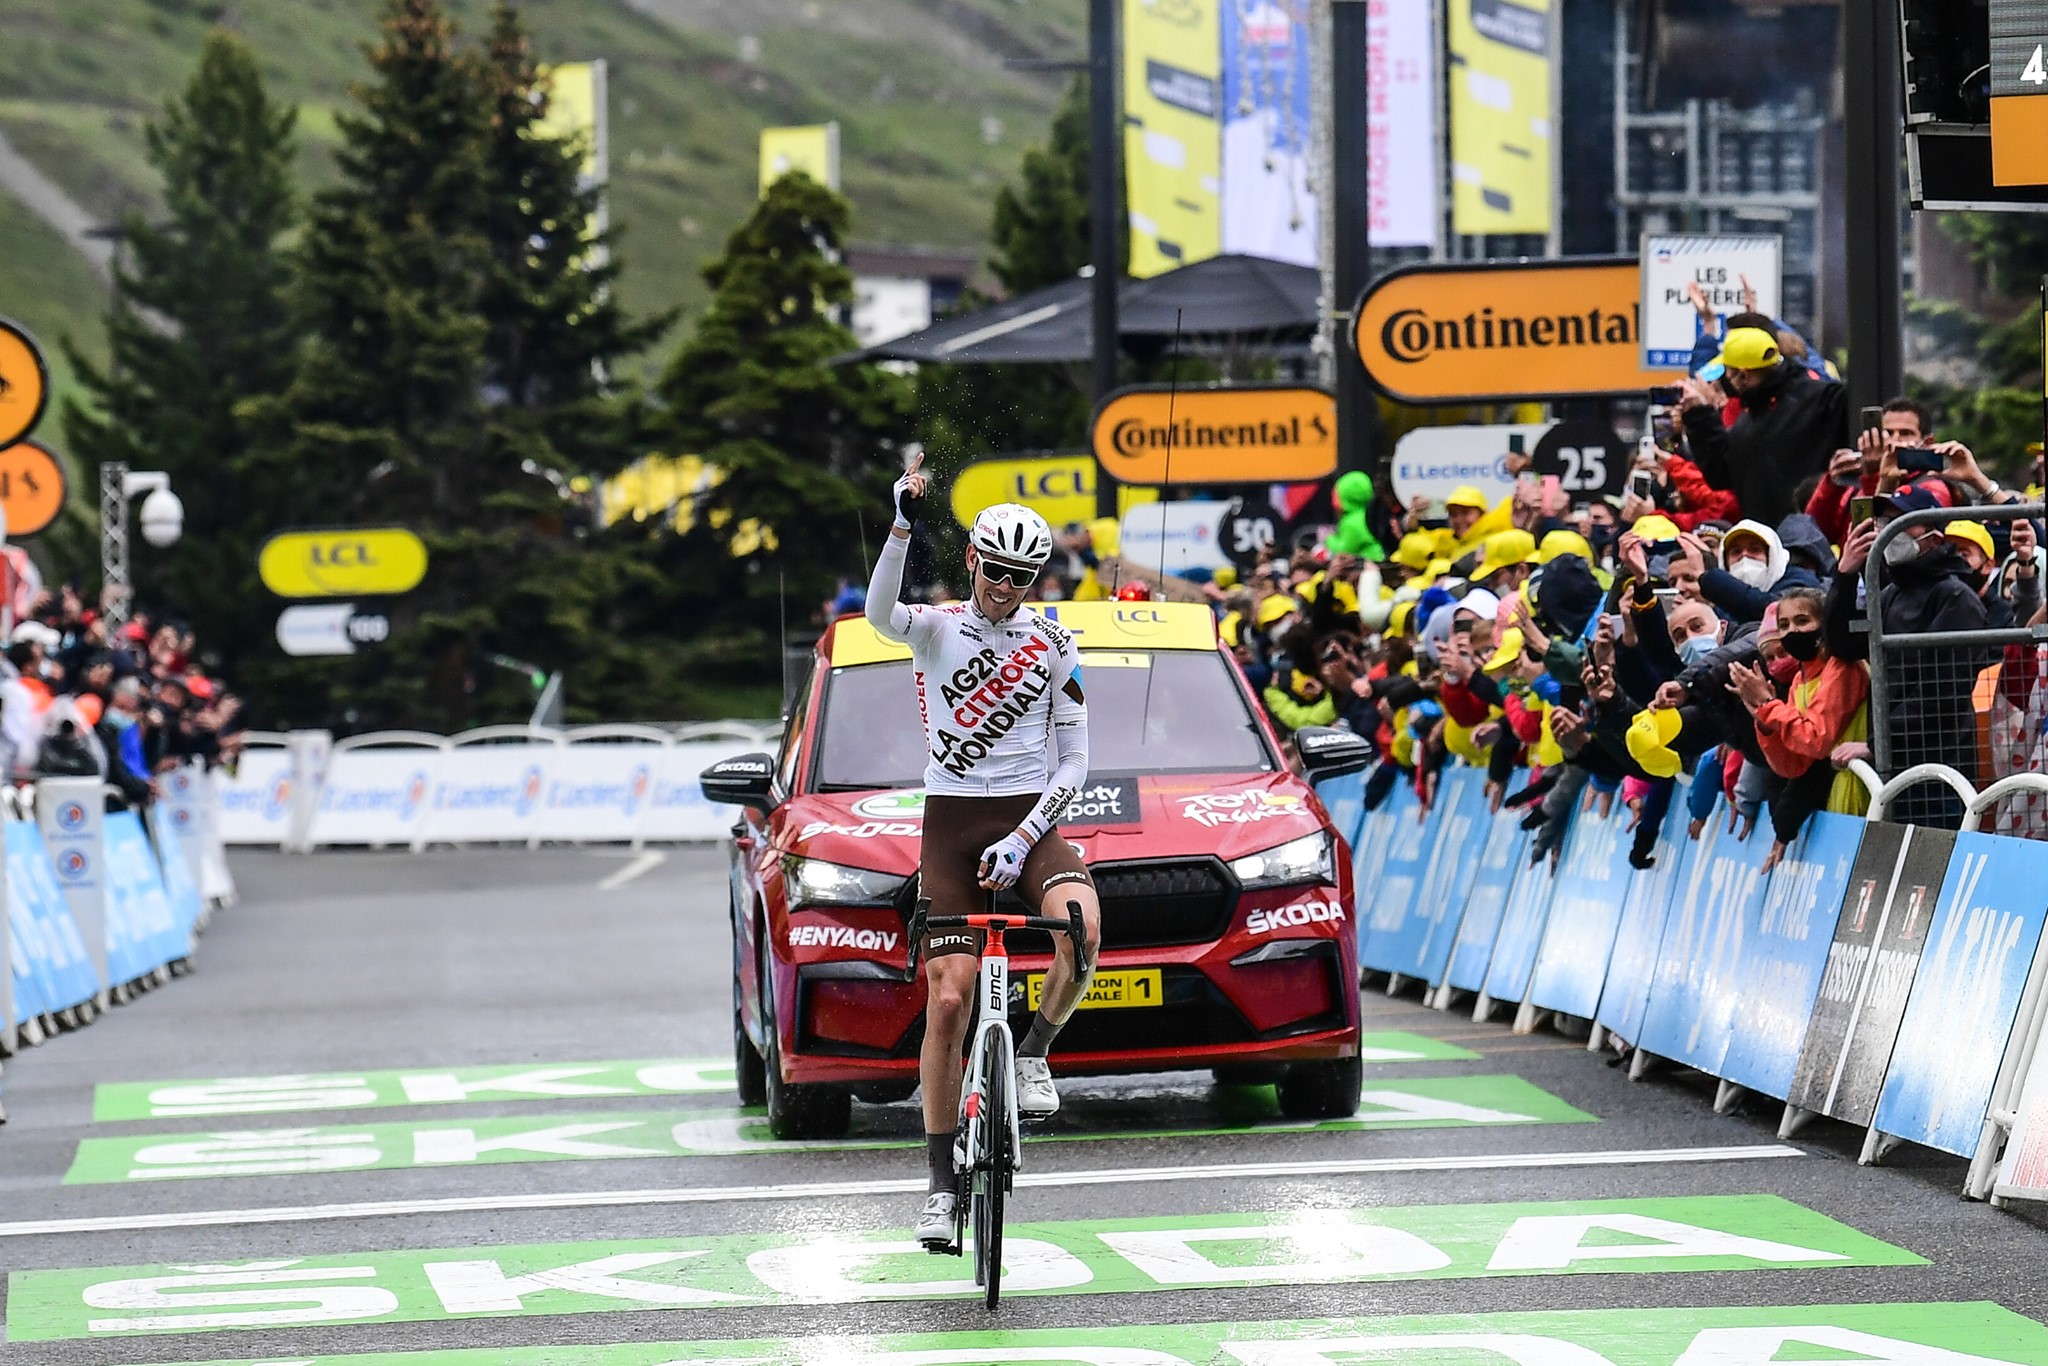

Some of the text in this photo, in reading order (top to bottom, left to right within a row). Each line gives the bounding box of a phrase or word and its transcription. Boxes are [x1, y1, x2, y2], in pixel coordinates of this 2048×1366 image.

[1696, 267, 1728, 284] LES
[1381, 302, 1641, 364] Continental
[1112, 415, 1301, 458] Continental
[1015, 471, 1095, 499] LCL
[1557, 446, 1608, 491] 25
[311, 542, 378, 567] LCL
[1232, 517, 1275, 552] 50
[1117, 609, 1168, 624] LCL
[1030, 617, 1069, 660] MONDIALE
[940, 648, 1004, 710] AG2R
[954, 634, 1050, 729] CITROËN
[943, 663, 1052, 780] MONDIALE
[932, 728, 962, 765] LA
[1040, 785, 1069, 819] AG2R LA
[1046, 785, 1078, 825] MONDIALE
[1246, 900, 1346, 935] ŠKODA
[930, 935, 974, 949] BMC
[990, 963, 1002, 1012] BMC
[1134, 978, 1151, 999] 1
[1819, 941, 1871, 1003] TISSOT
[82, 1212, 1853, 1333] ŠKODA
